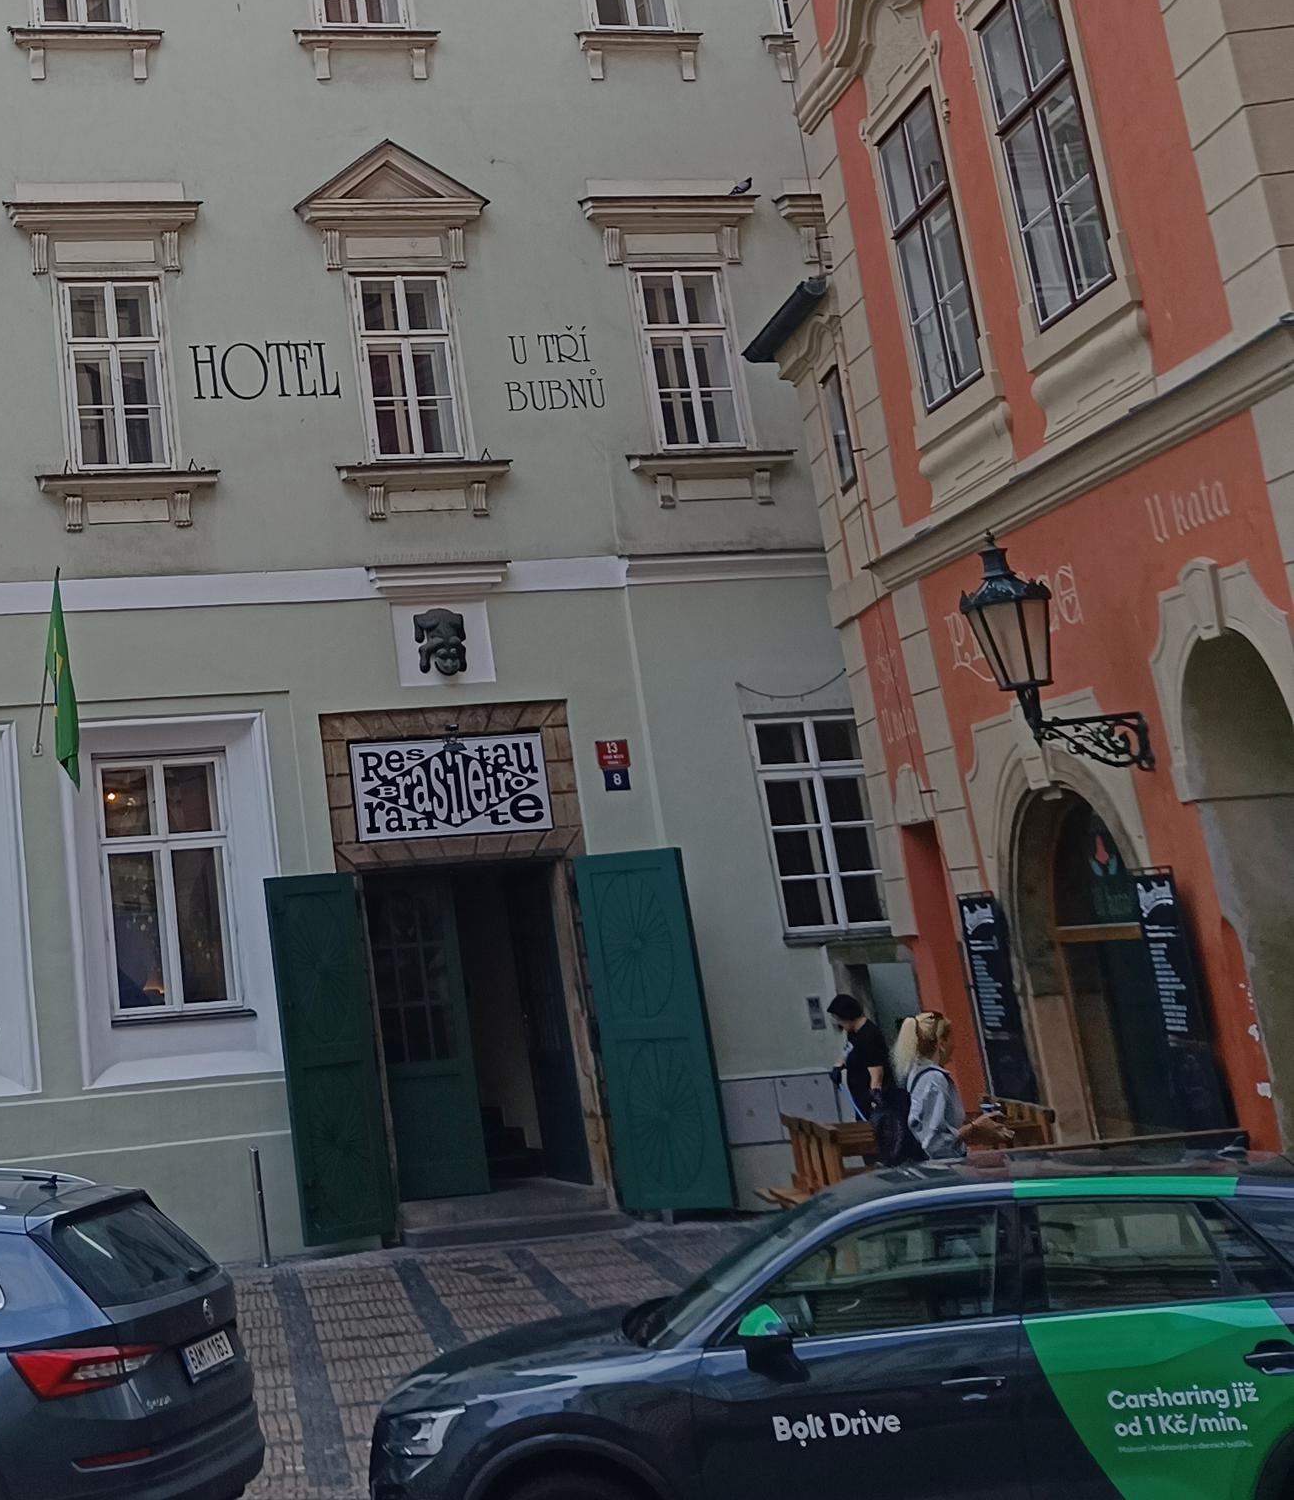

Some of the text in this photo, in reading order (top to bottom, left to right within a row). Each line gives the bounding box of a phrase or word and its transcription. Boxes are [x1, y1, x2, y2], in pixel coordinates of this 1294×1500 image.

[507, 325, 591, 365] U TŘÍ
[188, 339, 342, 401] HOTEL
[504, 368, 606, 412] BUBNŮ
[606, 742, 619, 754] 13
[376, 750, 529, 825] Brasileiro
[613, 773, 622, 786] 8
[1107, 1381, 1259, 1410] Carsharing již
[772, 1409, 902, 1448] Bolt Drive
[1114, 1411, 1249, 1437] od 1 Kč/min.
